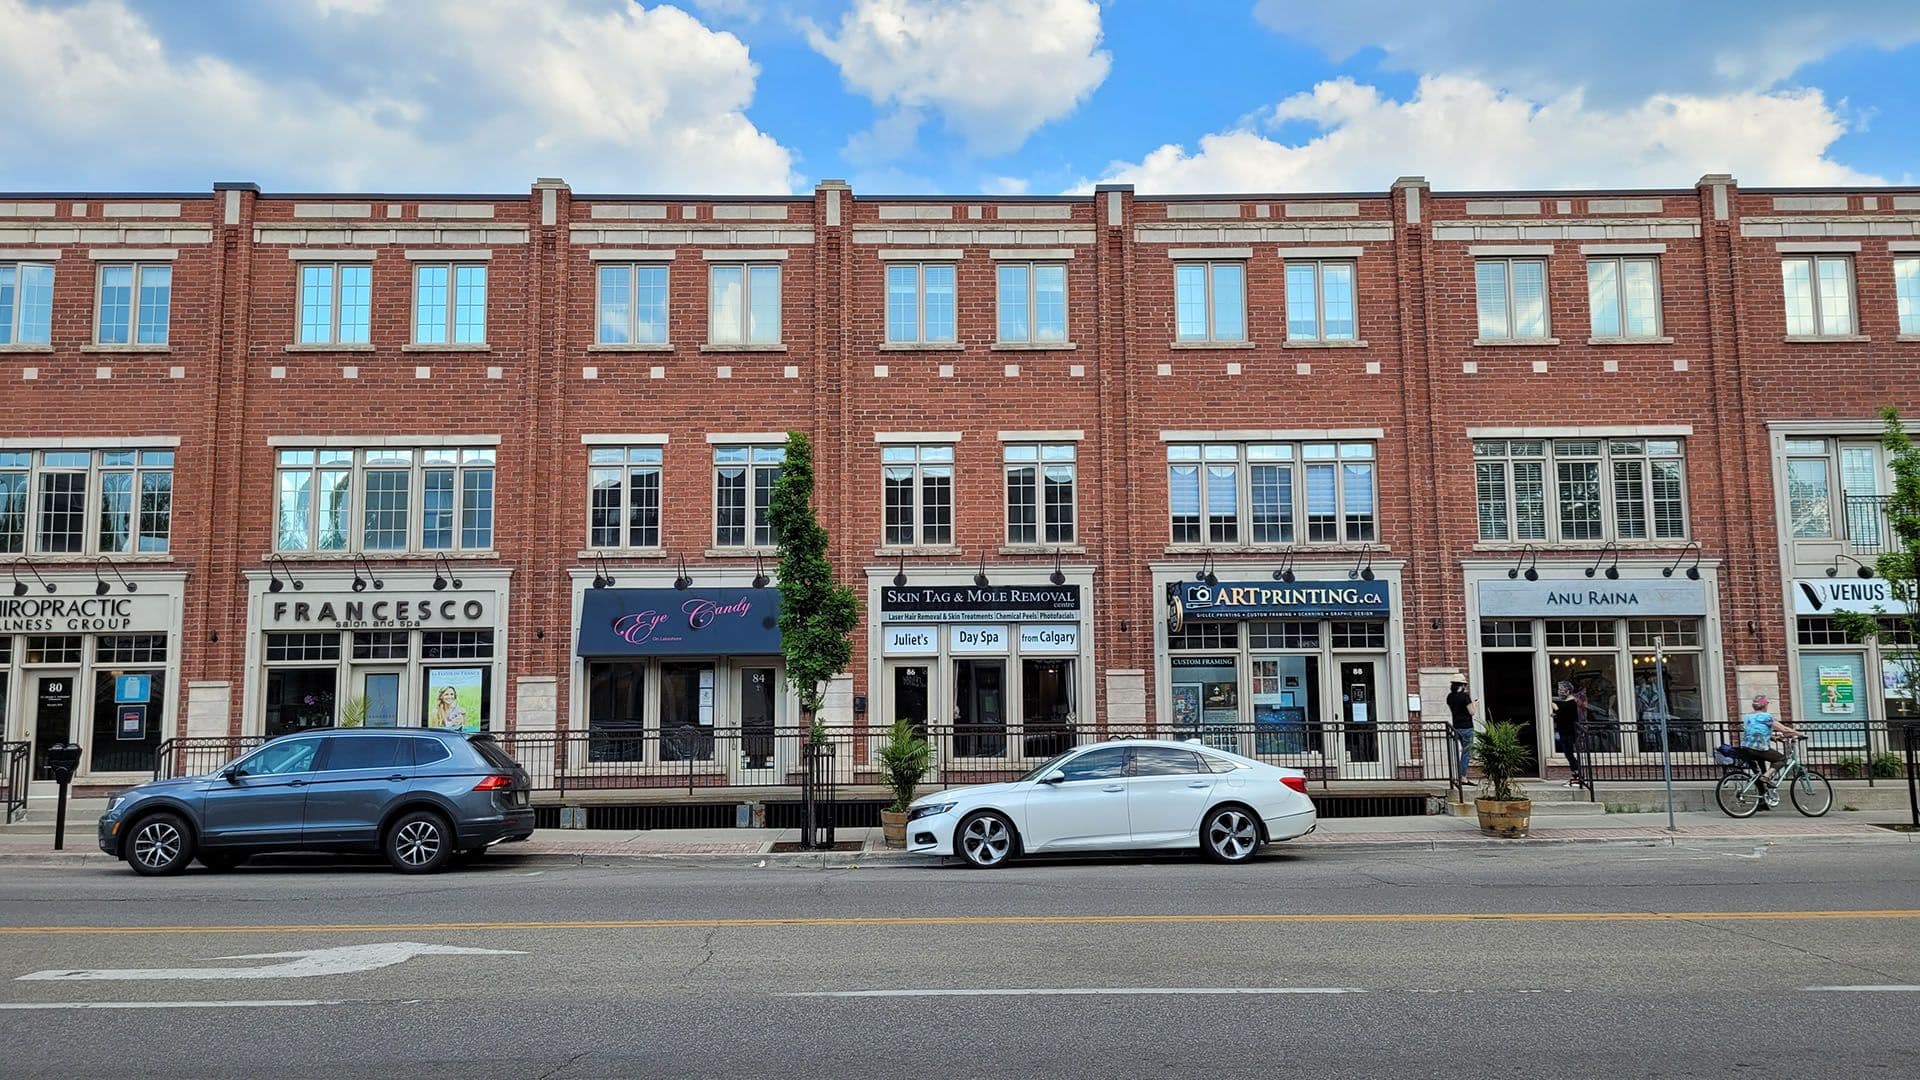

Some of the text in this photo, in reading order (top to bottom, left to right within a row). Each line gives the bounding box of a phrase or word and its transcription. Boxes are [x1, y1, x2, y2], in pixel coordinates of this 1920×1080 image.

[887, 589, 1075, 603] SKIN TAG & MOLE REMOVAL
[1546, 591, 1639, 605] ANU RAINA
[1829, 584, 1884, 600] VENUS
[0, 599, 131, 617] IROPRACTIC
[274, 600, 483, 621] FRANCESCO
[614, 596, 751, 645] Eye Candy
[961, 612, 993, 620] Treatments
[0, 619, 130, 630] LNESS GROUP
[336, 619, 421, 629] salon and spa
[893, 634, 929, 646] Juliet's
[959, 631, 999, 645] Day Spa
[1022, 631, 1075, 646] from Calgary
[752, 673, 766, 683] 84
[48, 682, 63, 693] 80
